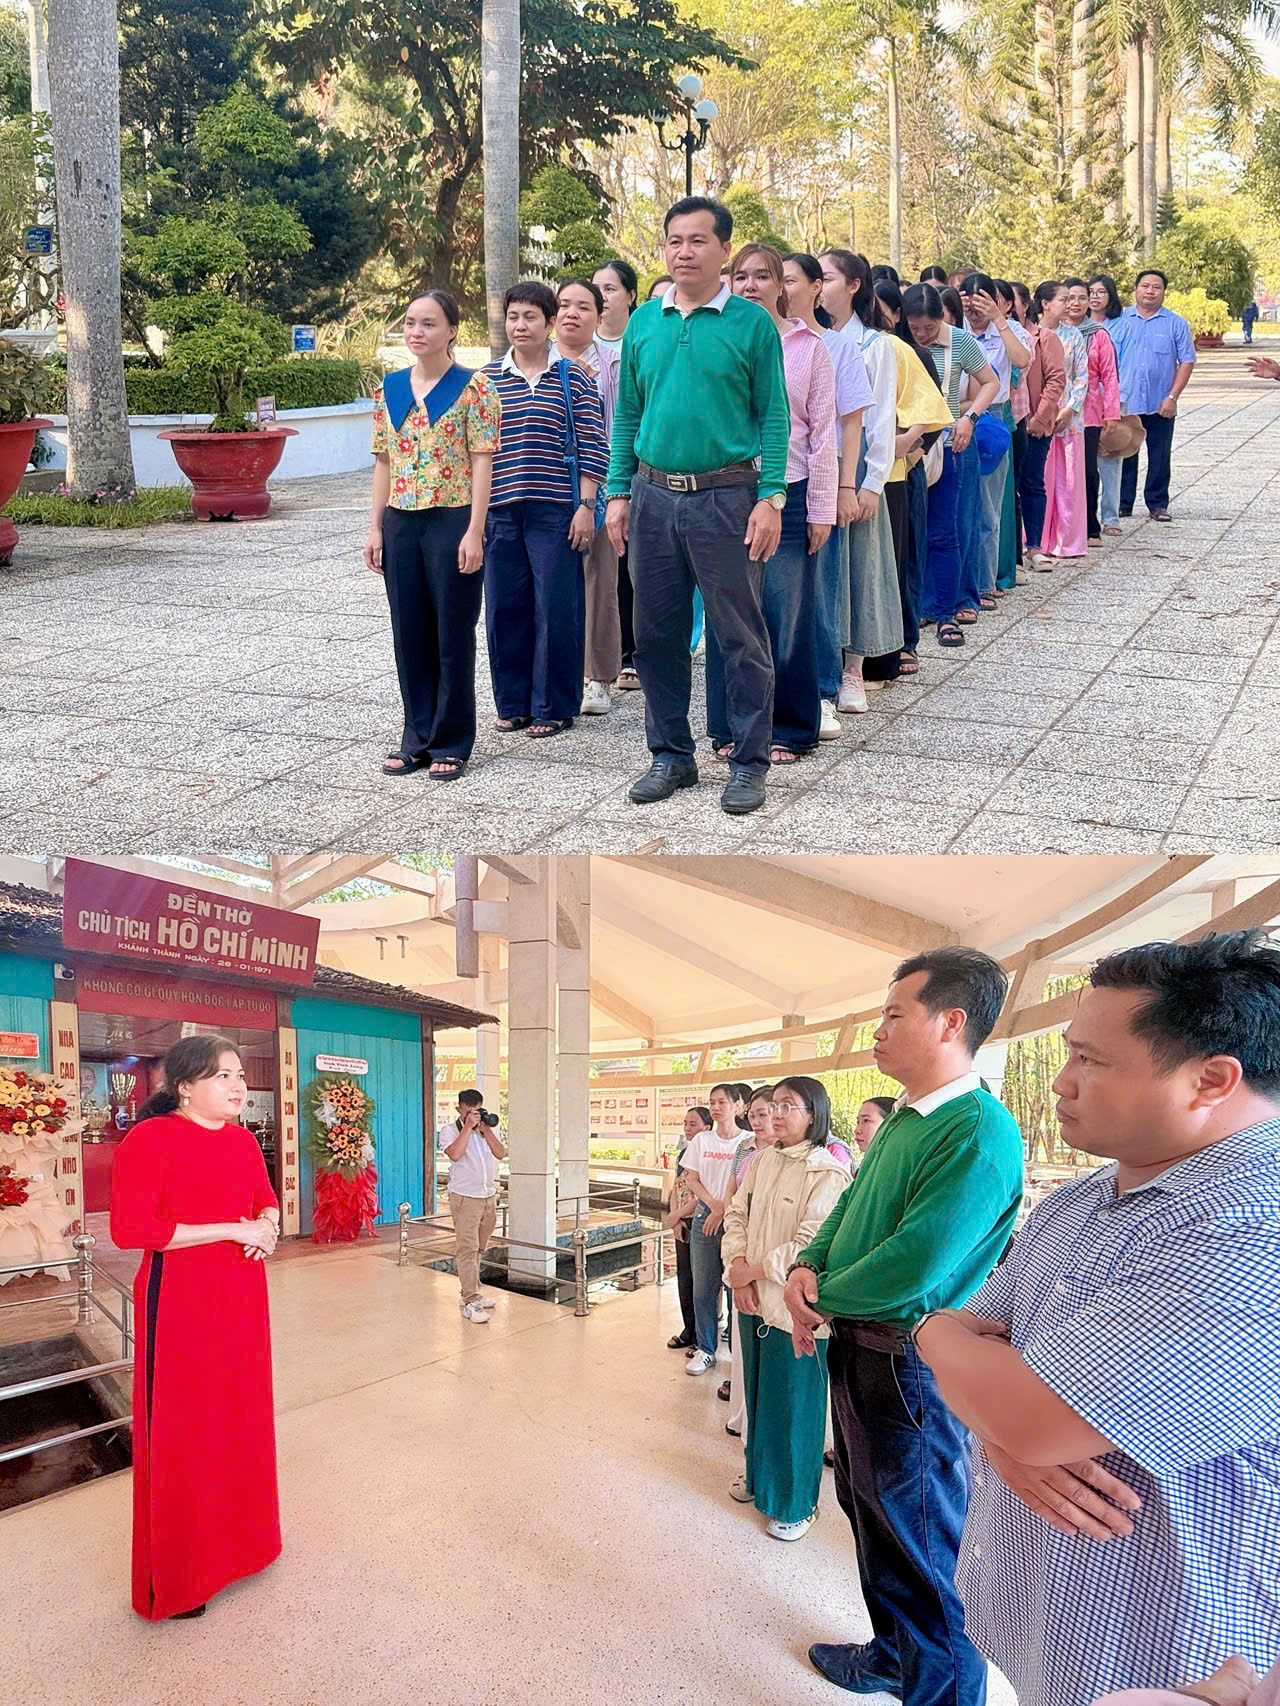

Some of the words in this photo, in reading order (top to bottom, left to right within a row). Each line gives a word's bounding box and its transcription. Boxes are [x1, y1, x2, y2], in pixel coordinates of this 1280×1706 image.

[167, 890, 215, 918] ĐỀN
[213, 905, 253, 926] THỜ
[78, 909, 111, 934] CHỦ
[114, 916, 150, 941] TỊCH
[157, 916, 201, 950] HỒ
[118, 942, 149, 954] KHÁNH
[152, 947, 181, 959] THÀNH
[185, 953, 210, 965] NGÀY
[60, 1062, 75, 1080] CAO
[703, 1151, 734, 1161] L'AMOU
